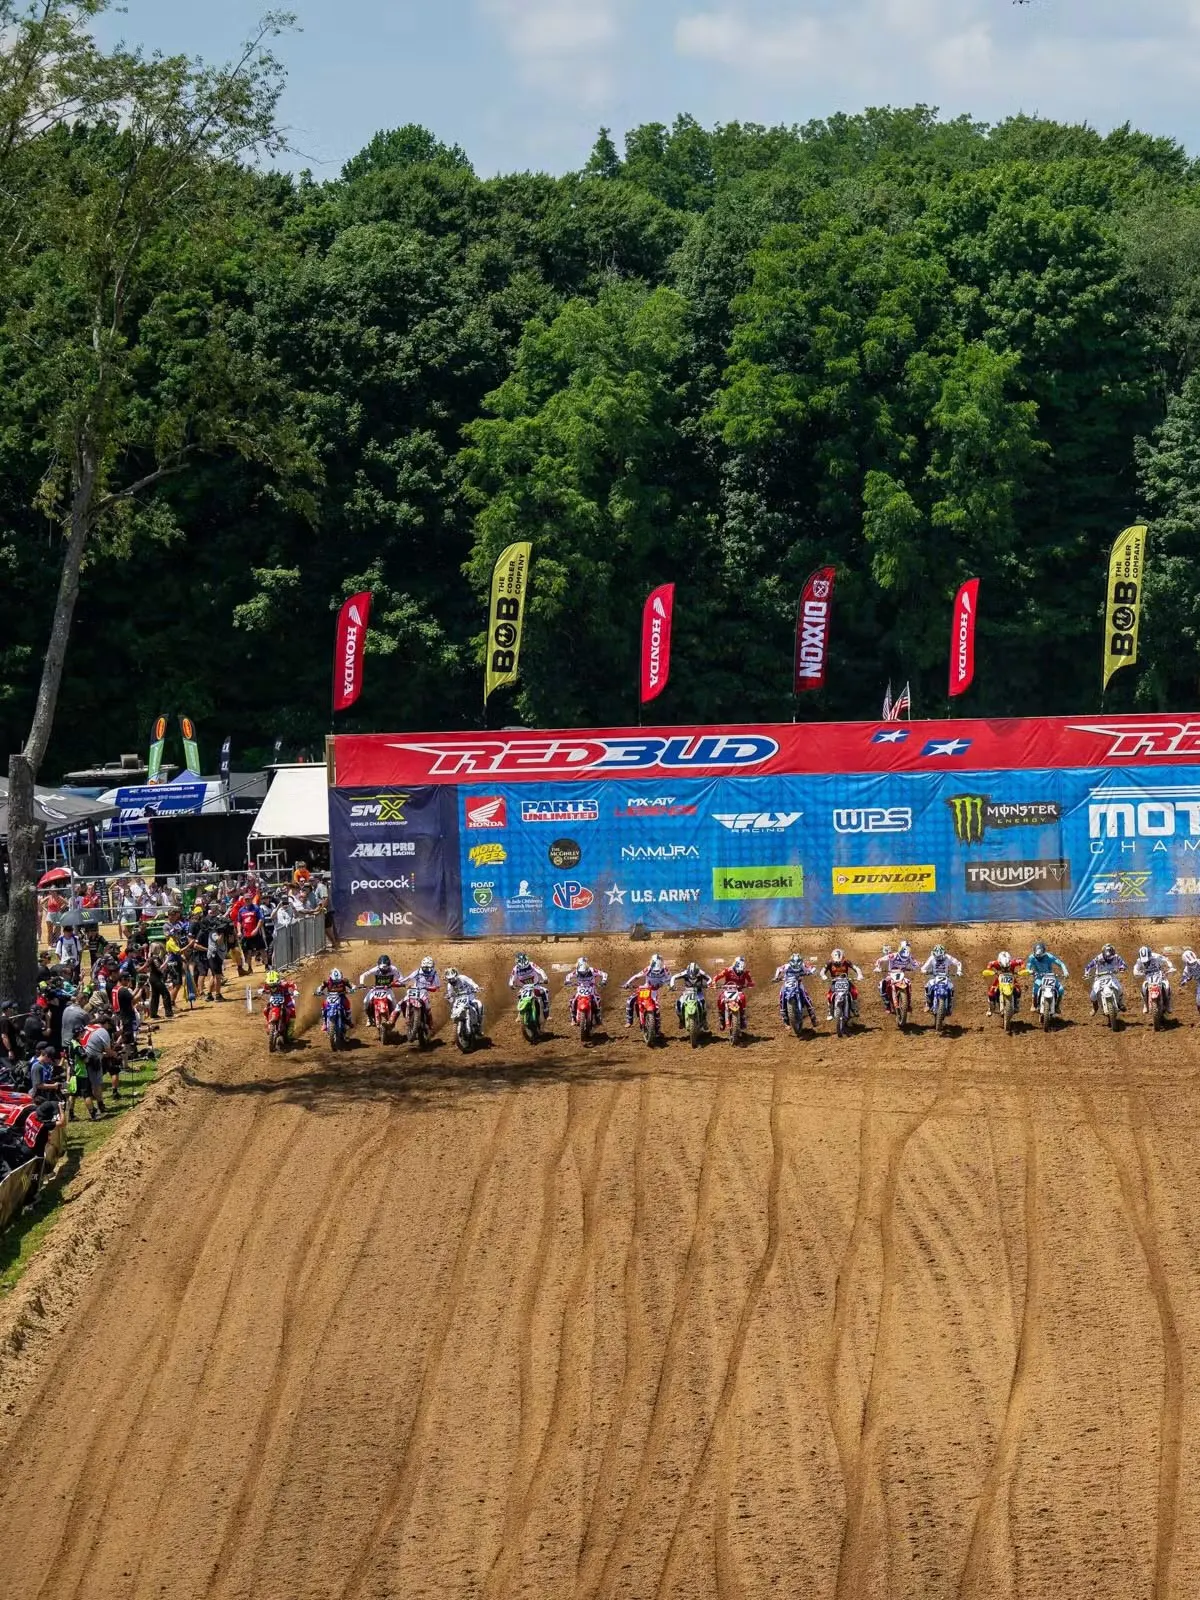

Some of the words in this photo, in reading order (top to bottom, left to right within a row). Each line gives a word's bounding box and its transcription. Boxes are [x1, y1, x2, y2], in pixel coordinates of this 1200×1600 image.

[1124, 544, 1132, 578] COOLER
[1132, 537, 1141, 578] COMPANY
[507, 560, 516, 594] COOLER
[515, 553, 525, 595] COMPANY
[498, 576, 506, 593] THE
[1111, 581, 1138, 656] BOB
[491, 596, 520, 673] BOB
[799, 600, 827, 679] DIXXON
[650, 618, 661, 688] HONDA
[958, 612, 968, 681] HONDA
[344, 626, 357, 696] HONDA
[386, 734, 779, 775] REDBUD
[350, 799, 406, 820] SMX
[522, 800, 597, 813] PARTS
[628, 797, 676, 806] MX-ATV
[986, 803, 1058, 816] MONSTER
[523, 812, 598, 820] UNLIMITED
[711, 812, 804, 829] FLY
[833, 808, 912, 832] WPS
[348, 842, 392, 857] AMA
[392, 842, 416, 851] PRO
[469, 844, 502, 858] MOTO
[621, 844, 698, 857] NAMURA
[475, 850, 507, 868] TEES
[723, 876, 793, 889] Kawasaki
[851, 872, 932, 884] DUNLOP
[967, 866, 1047, 884] TRIUMPH
[351, 875, 410, 894] peacock
[1092, 877, 1148, 897] SMX
[479, 894, 487, 903] 2
[553, 880, 582, 909] VP
[631, 890, 656, 902] U.S.
[661, 889, 700, 902] ARMY
[383, 912, 413, 925] NBC
[937, 976, 947, 984] 2
[522, 989, 532, 998] 21
[727, 991, 738, 999] 7
